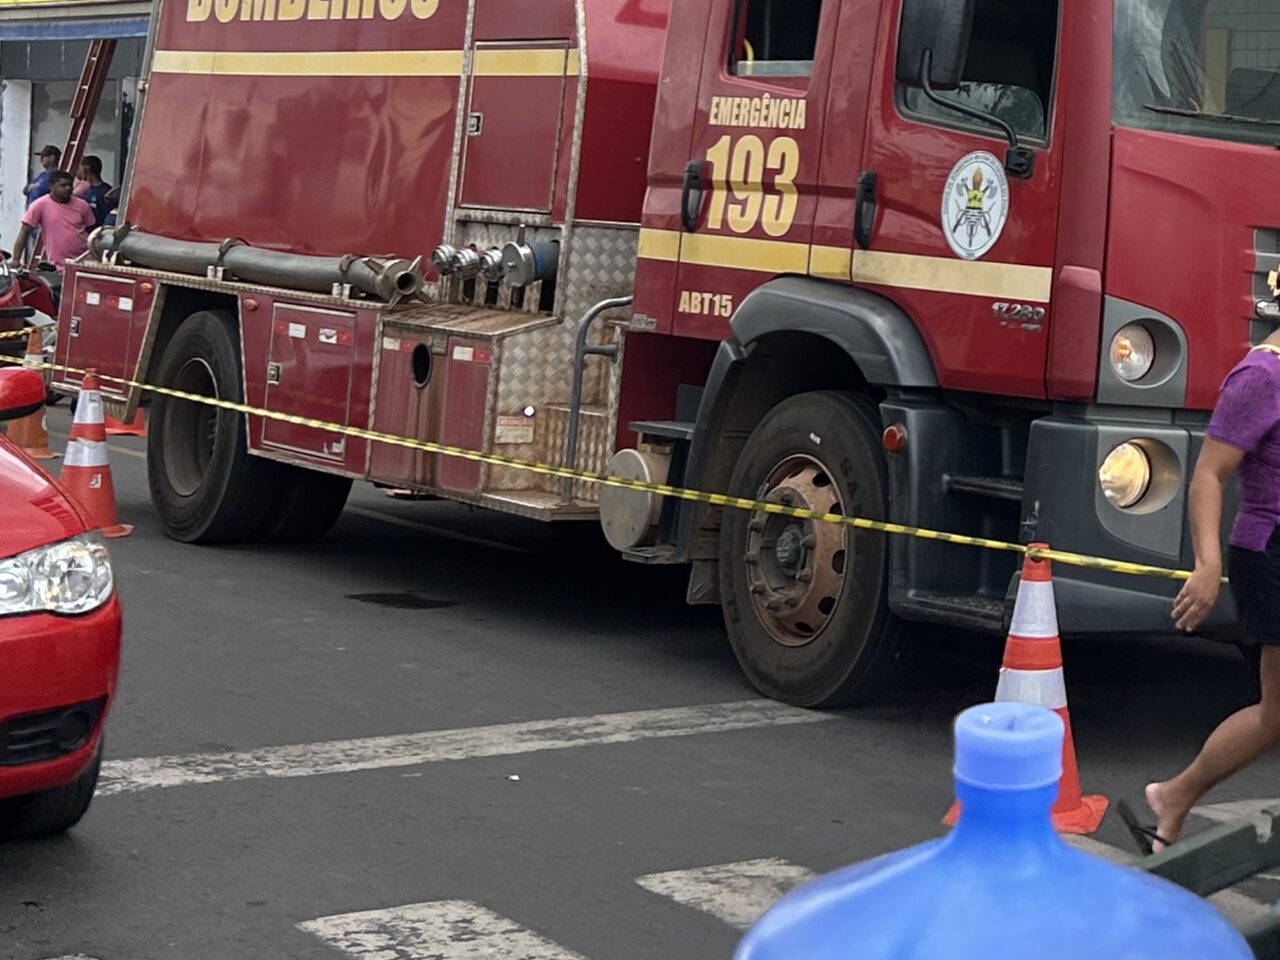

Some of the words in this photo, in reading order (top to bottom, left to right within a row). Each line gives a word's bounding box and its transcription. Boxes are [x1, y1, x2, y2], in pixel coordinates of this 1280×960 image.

[708, 93, 807, 130] EMERGÊNCIA
[706, 135, 800, 237] 193
[678, 291, 733, 318] ABT15
